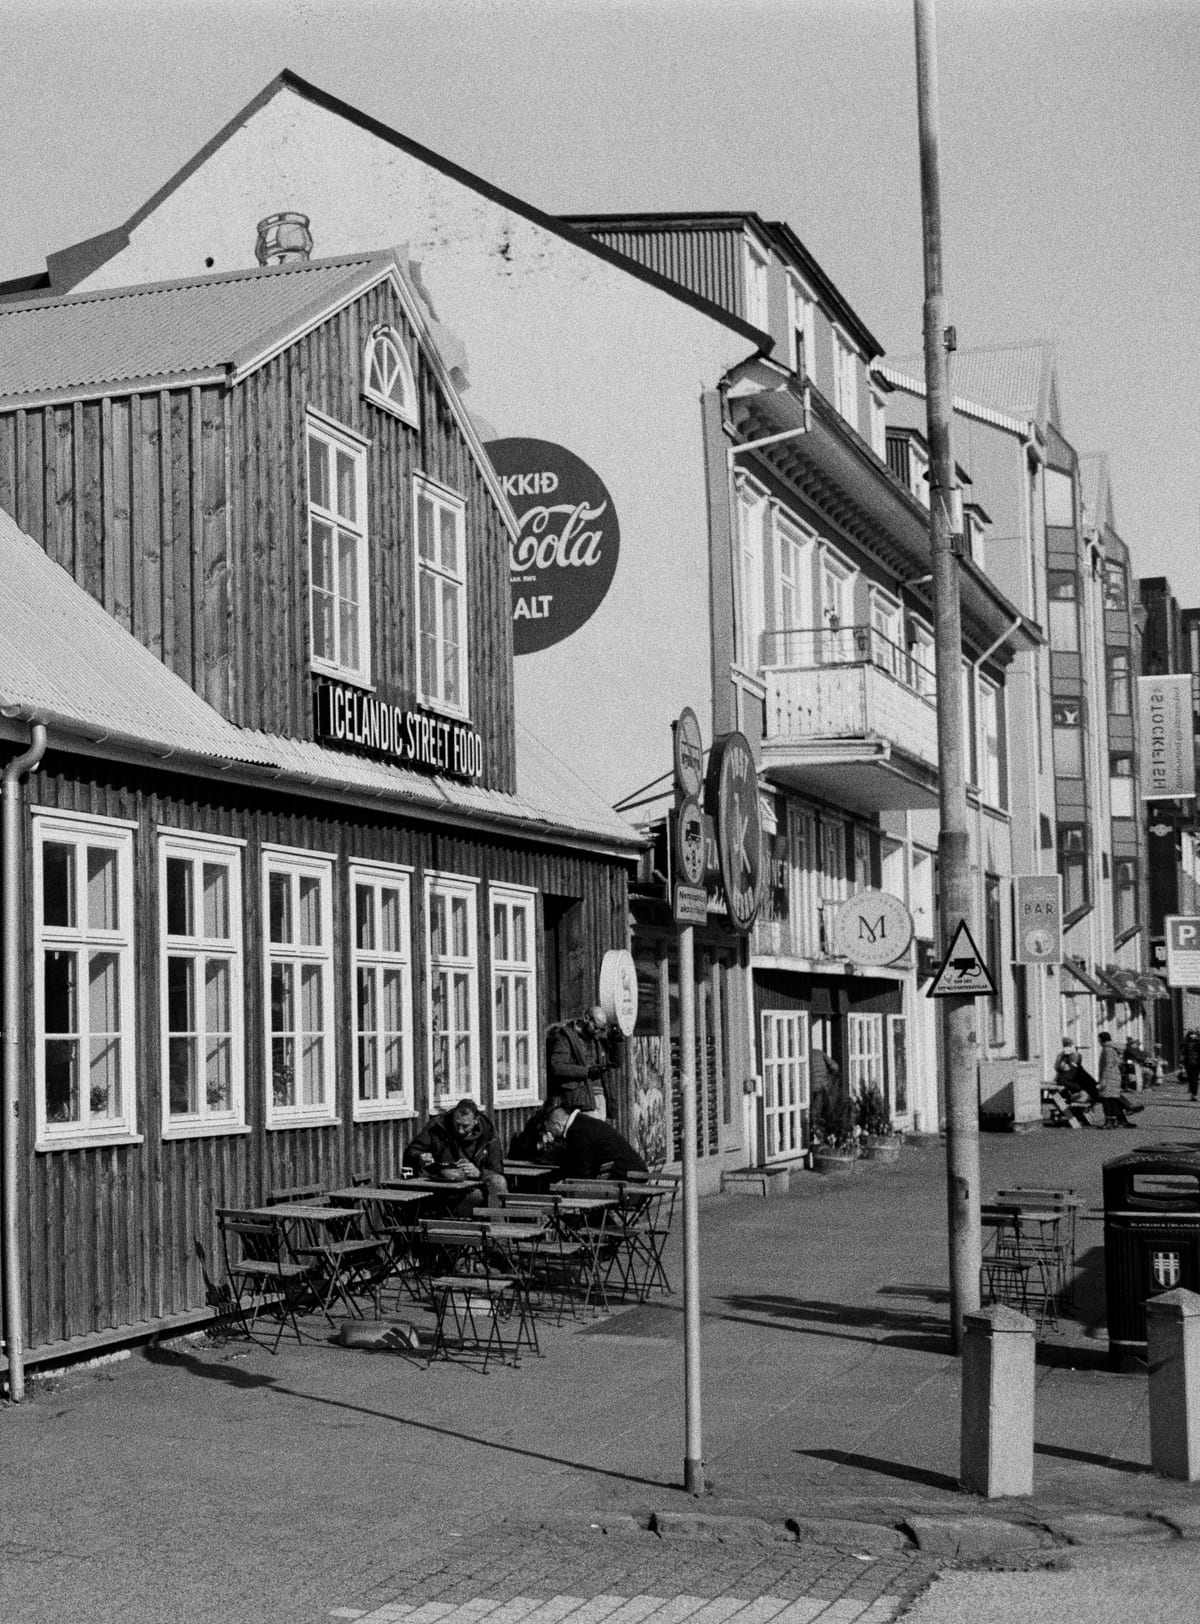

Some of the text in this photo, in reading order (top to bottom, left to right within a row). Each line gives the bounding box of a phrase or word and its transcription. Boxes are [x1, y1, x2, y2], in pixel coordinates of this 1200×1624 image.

[497, 471, 559, 496] KKIÐ
[511, 595, 553, 620] ALT
[329, 685, 483, 777] ICELANDIC STREET FOOD
[1024, 903, 1054, 914] BAR
